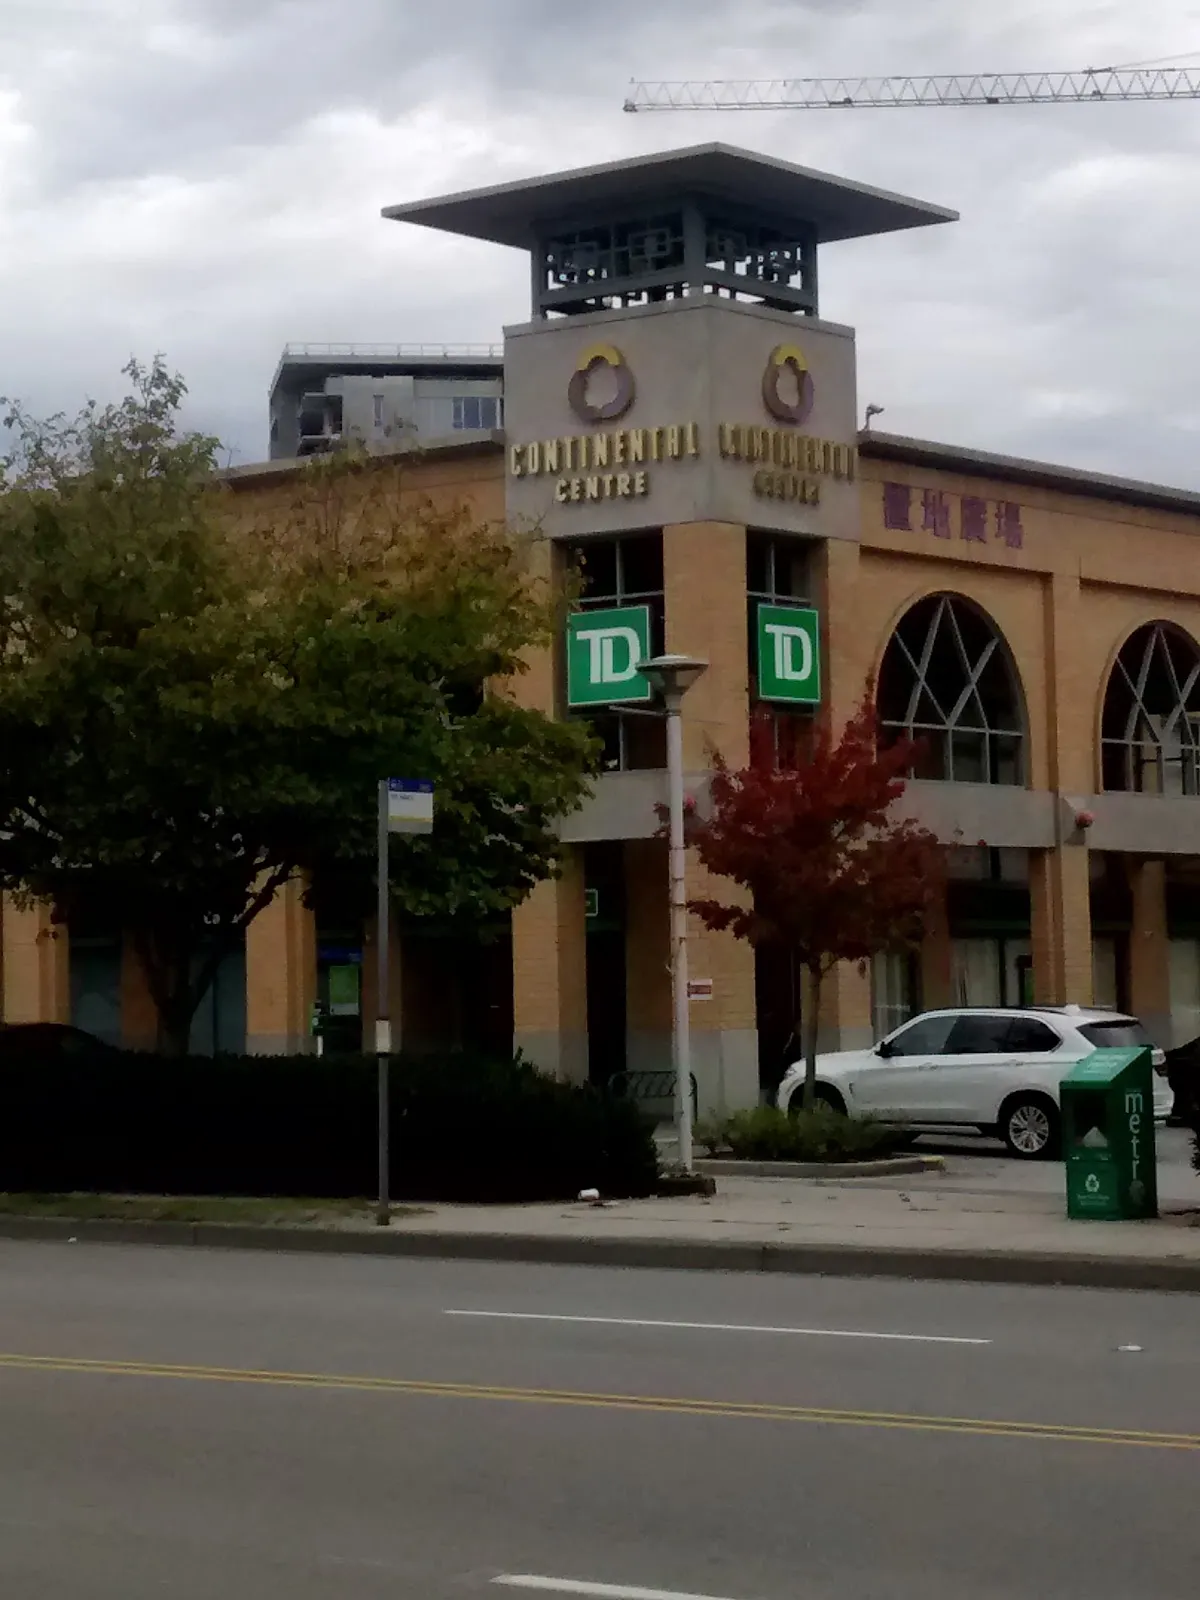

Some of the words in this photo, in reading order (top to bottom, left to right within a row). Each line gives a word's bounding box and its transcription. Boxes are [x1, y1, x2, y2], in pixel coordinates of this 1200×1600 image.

[510, 420, 698, 476] CONTINENTAL
[555, 470, 648, 503] CENTRE
[576, 626, 642, 684] TD
[764, 623, 813, 681] TD
